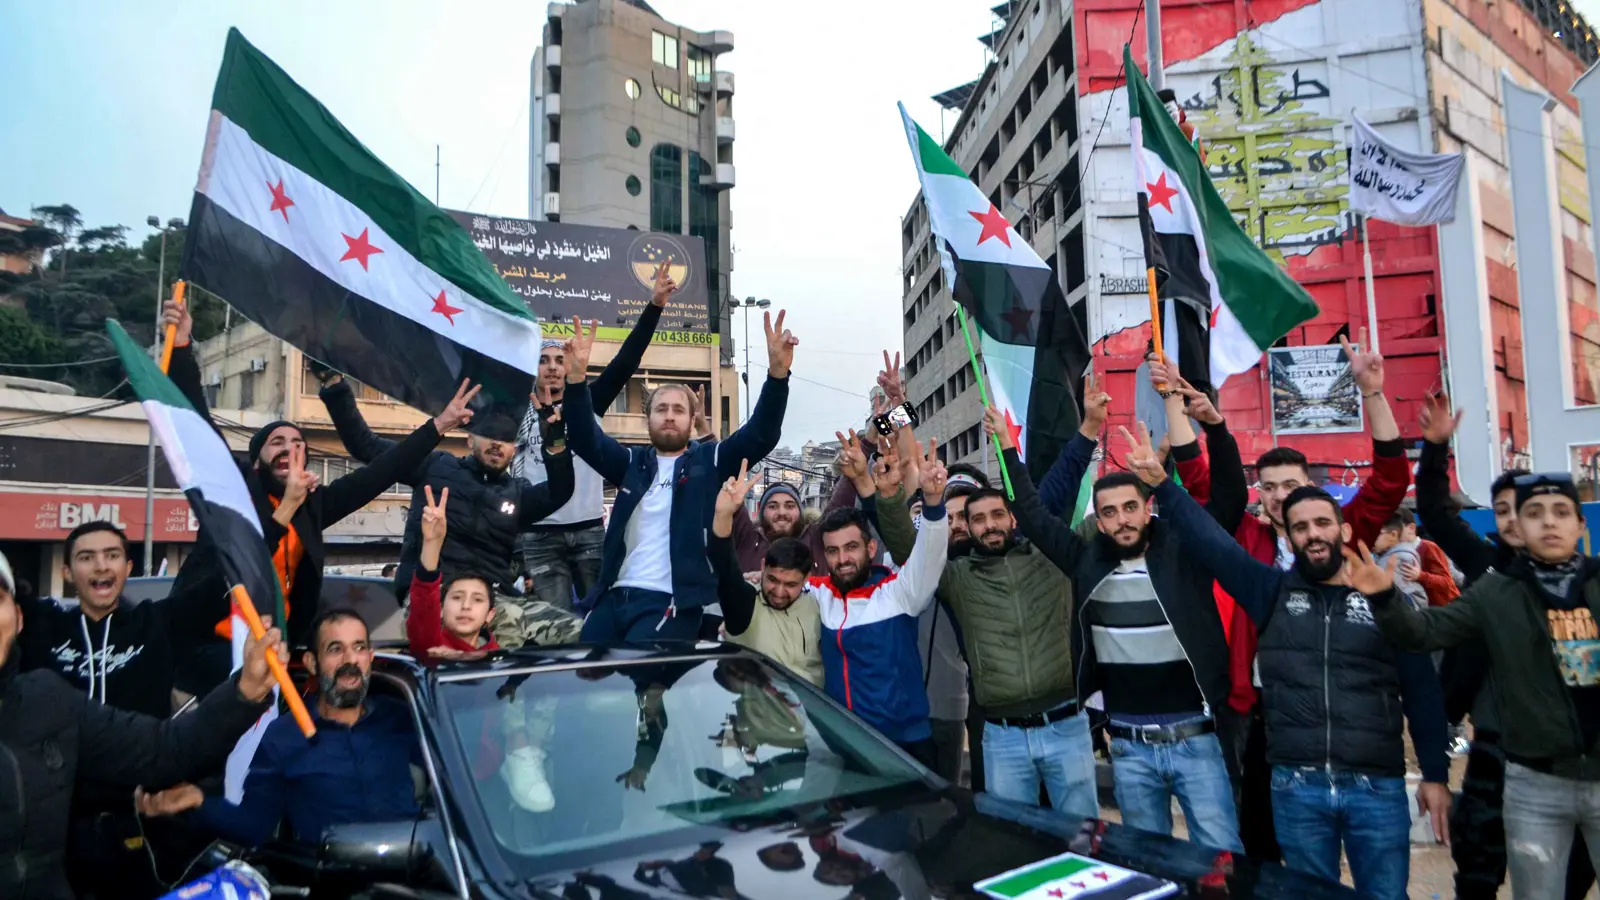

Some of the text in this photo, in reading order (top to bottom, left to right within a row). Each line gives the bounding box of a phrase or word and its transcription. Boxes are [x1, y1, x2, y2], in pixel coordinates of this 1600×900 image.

[1208, 149, 1328, 184] مدين
[529, 266, 567, 283] مربط
[524, 284, 553, 298] بحلول
[554, 287, 589, 299] المسلمين
[664, 302, 707, 310] RABIANS
[669, 332, 690, 343] 438
[692, 333, 712, 344] 666
[59, 502, 127, 530] BML
[34, 519, 57, 529] لبنان
[165, 523, 186, 532] لبنان
